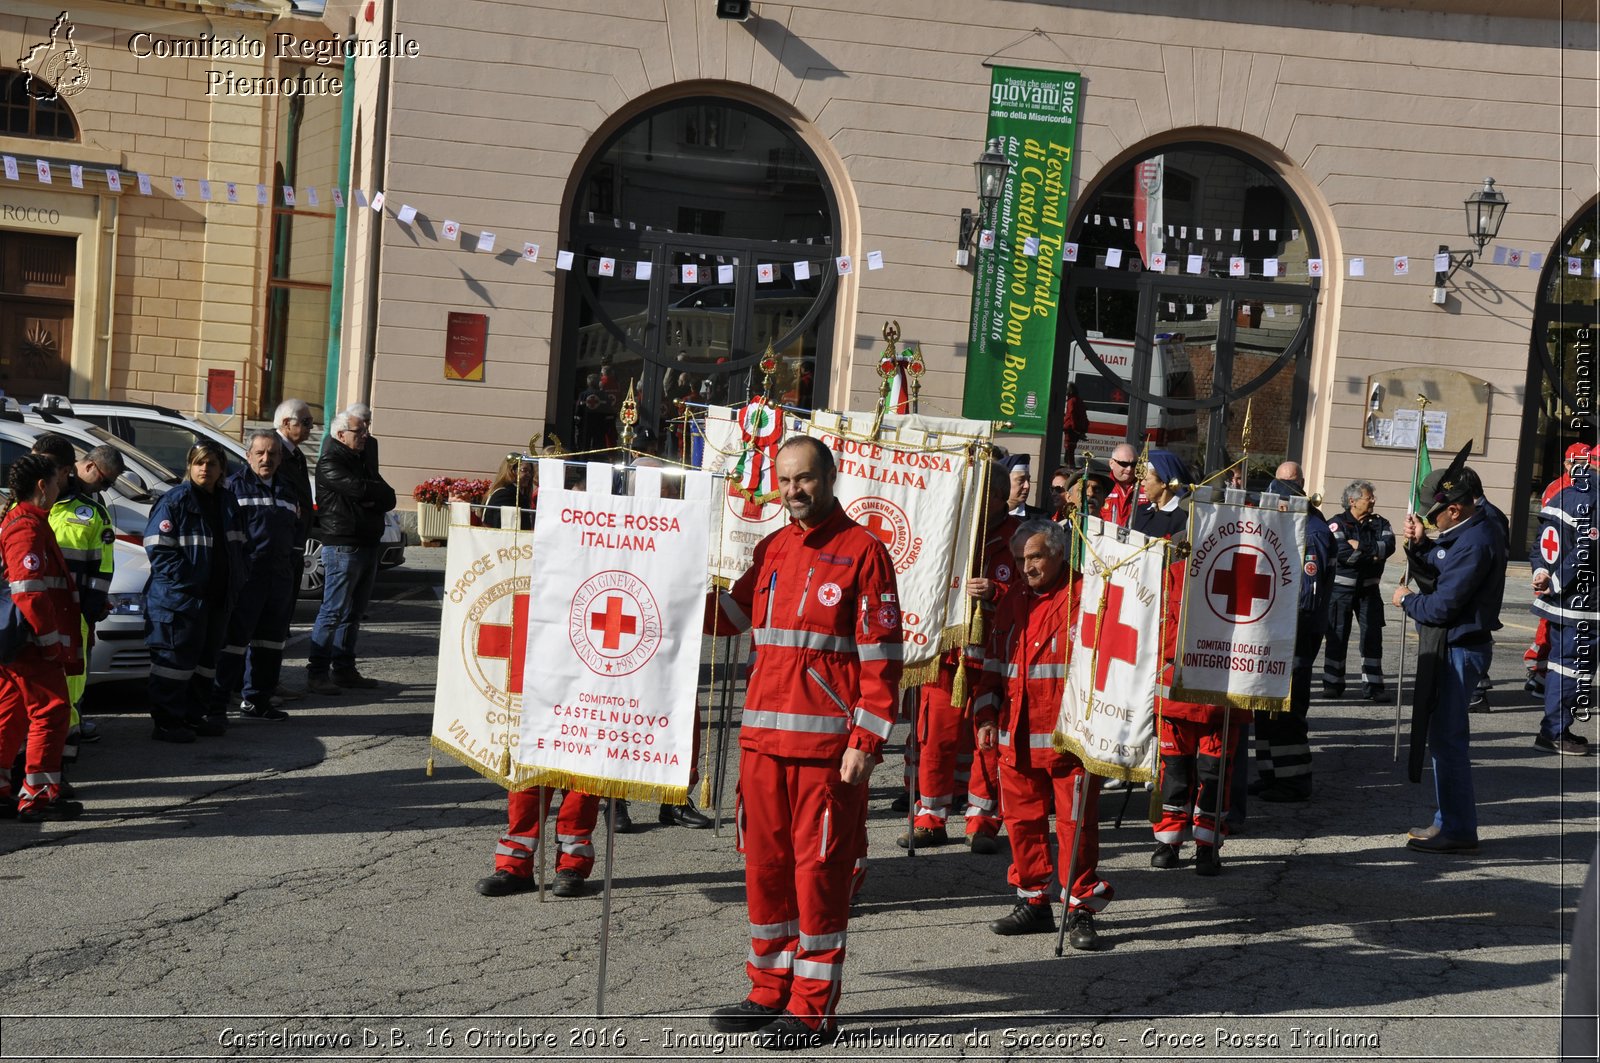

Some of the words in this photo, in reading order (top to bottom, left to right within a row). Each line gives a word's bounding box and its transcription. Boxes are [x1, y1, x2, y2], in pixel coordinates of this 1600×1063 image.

[992, 83, 1060, 105] giovani
[1028, 79, 1039, 88] che
[1062, 81, 1076, 114] 2016
[991, 110, 1008, 118] anno
[1010, 111, 1027, 120] della
[1029, 112, 1072, 124] Misericordia
[1008, 136, 1020, 157] dal
[1024, 138, 1047, 161] di
[1008, 159, 1018, 175] 24
[1041, 141, 1071, 229] Festival
[3, 204, 60, 225] ROCCO
[1001, 177, 1014, 236] settembre
[1000, 238, 1010, 252] al
[998, 255, 1008, 263] 1
[976, 264, 984, 289] teatrale
[995, 264, 1007, 308] ottobre
[1033, 233, 1062, 317] Teatrale
[973, 297, 981, 312] altre
[971, 313, 979, 342] sorprese
[981, 310, 989, 331] Piccoli
[991, 310, 1004, 342] 2016
[1007, 301, 1031, 346] Don
[979, 333, 987, 354] Lettori
[1000, 351, 1026, 416] Bosco
[820, 434, 883, 461] CROCE
[892, 450, 951, 473] ROSSA
[838, 458, 927, 490] ITALIANA
[853, 506, 861, 514] DI
[861, 501, 895, 515] GINEVRA
[561, 508, 616, 528] CROCE
[624, 514, 680, 532] ROSSA
[893, 514, 903, 525] 22
[581, 531, 656, 552] ITALIANA
[895, 525, 907, 556] AGOSTO
[1190, 534, 1218, 577] CROCE
[1218, 520, 1262, 539] ROSSA
[1264, 528, 1292, 587] ITALIANA
[450, 553, 495, 603] CROCE
[497, 544, 533, 564] ROS
[585, 581, 598, 595] DI
[598, 574, 642, 598] GINEVRA
[469, 577, 531, 622] CONVENZION
[640, 598, 653, 611] 22
[572, 593, 603, 670] CONVENZIONE
[636, 615, 658, 658] AGOSTO
[1197, 639, 1231, 651] COMITATO
[1233, 643, 1262, 656] LOCALE
[1263, 647, 1271, 656] DI
[617, 655, 638, 671] 1864
[1257, 660, 1286, 675] D'ASTI
[579, 692, 625, 707] COMITATO
[629, 698, 639, 708] DI
[553, 704, 669, 728] CASTELNUOVO
[490, 732, 520, 747] LOC
[561, 724, 588, 738] DON
[597, 729, 655, 745] BOSCO
[537, 738, 544, 749] E
[607, 747, 679, 765] MASSAIA
[1100, 738, 1145, 758] D'ASTI
